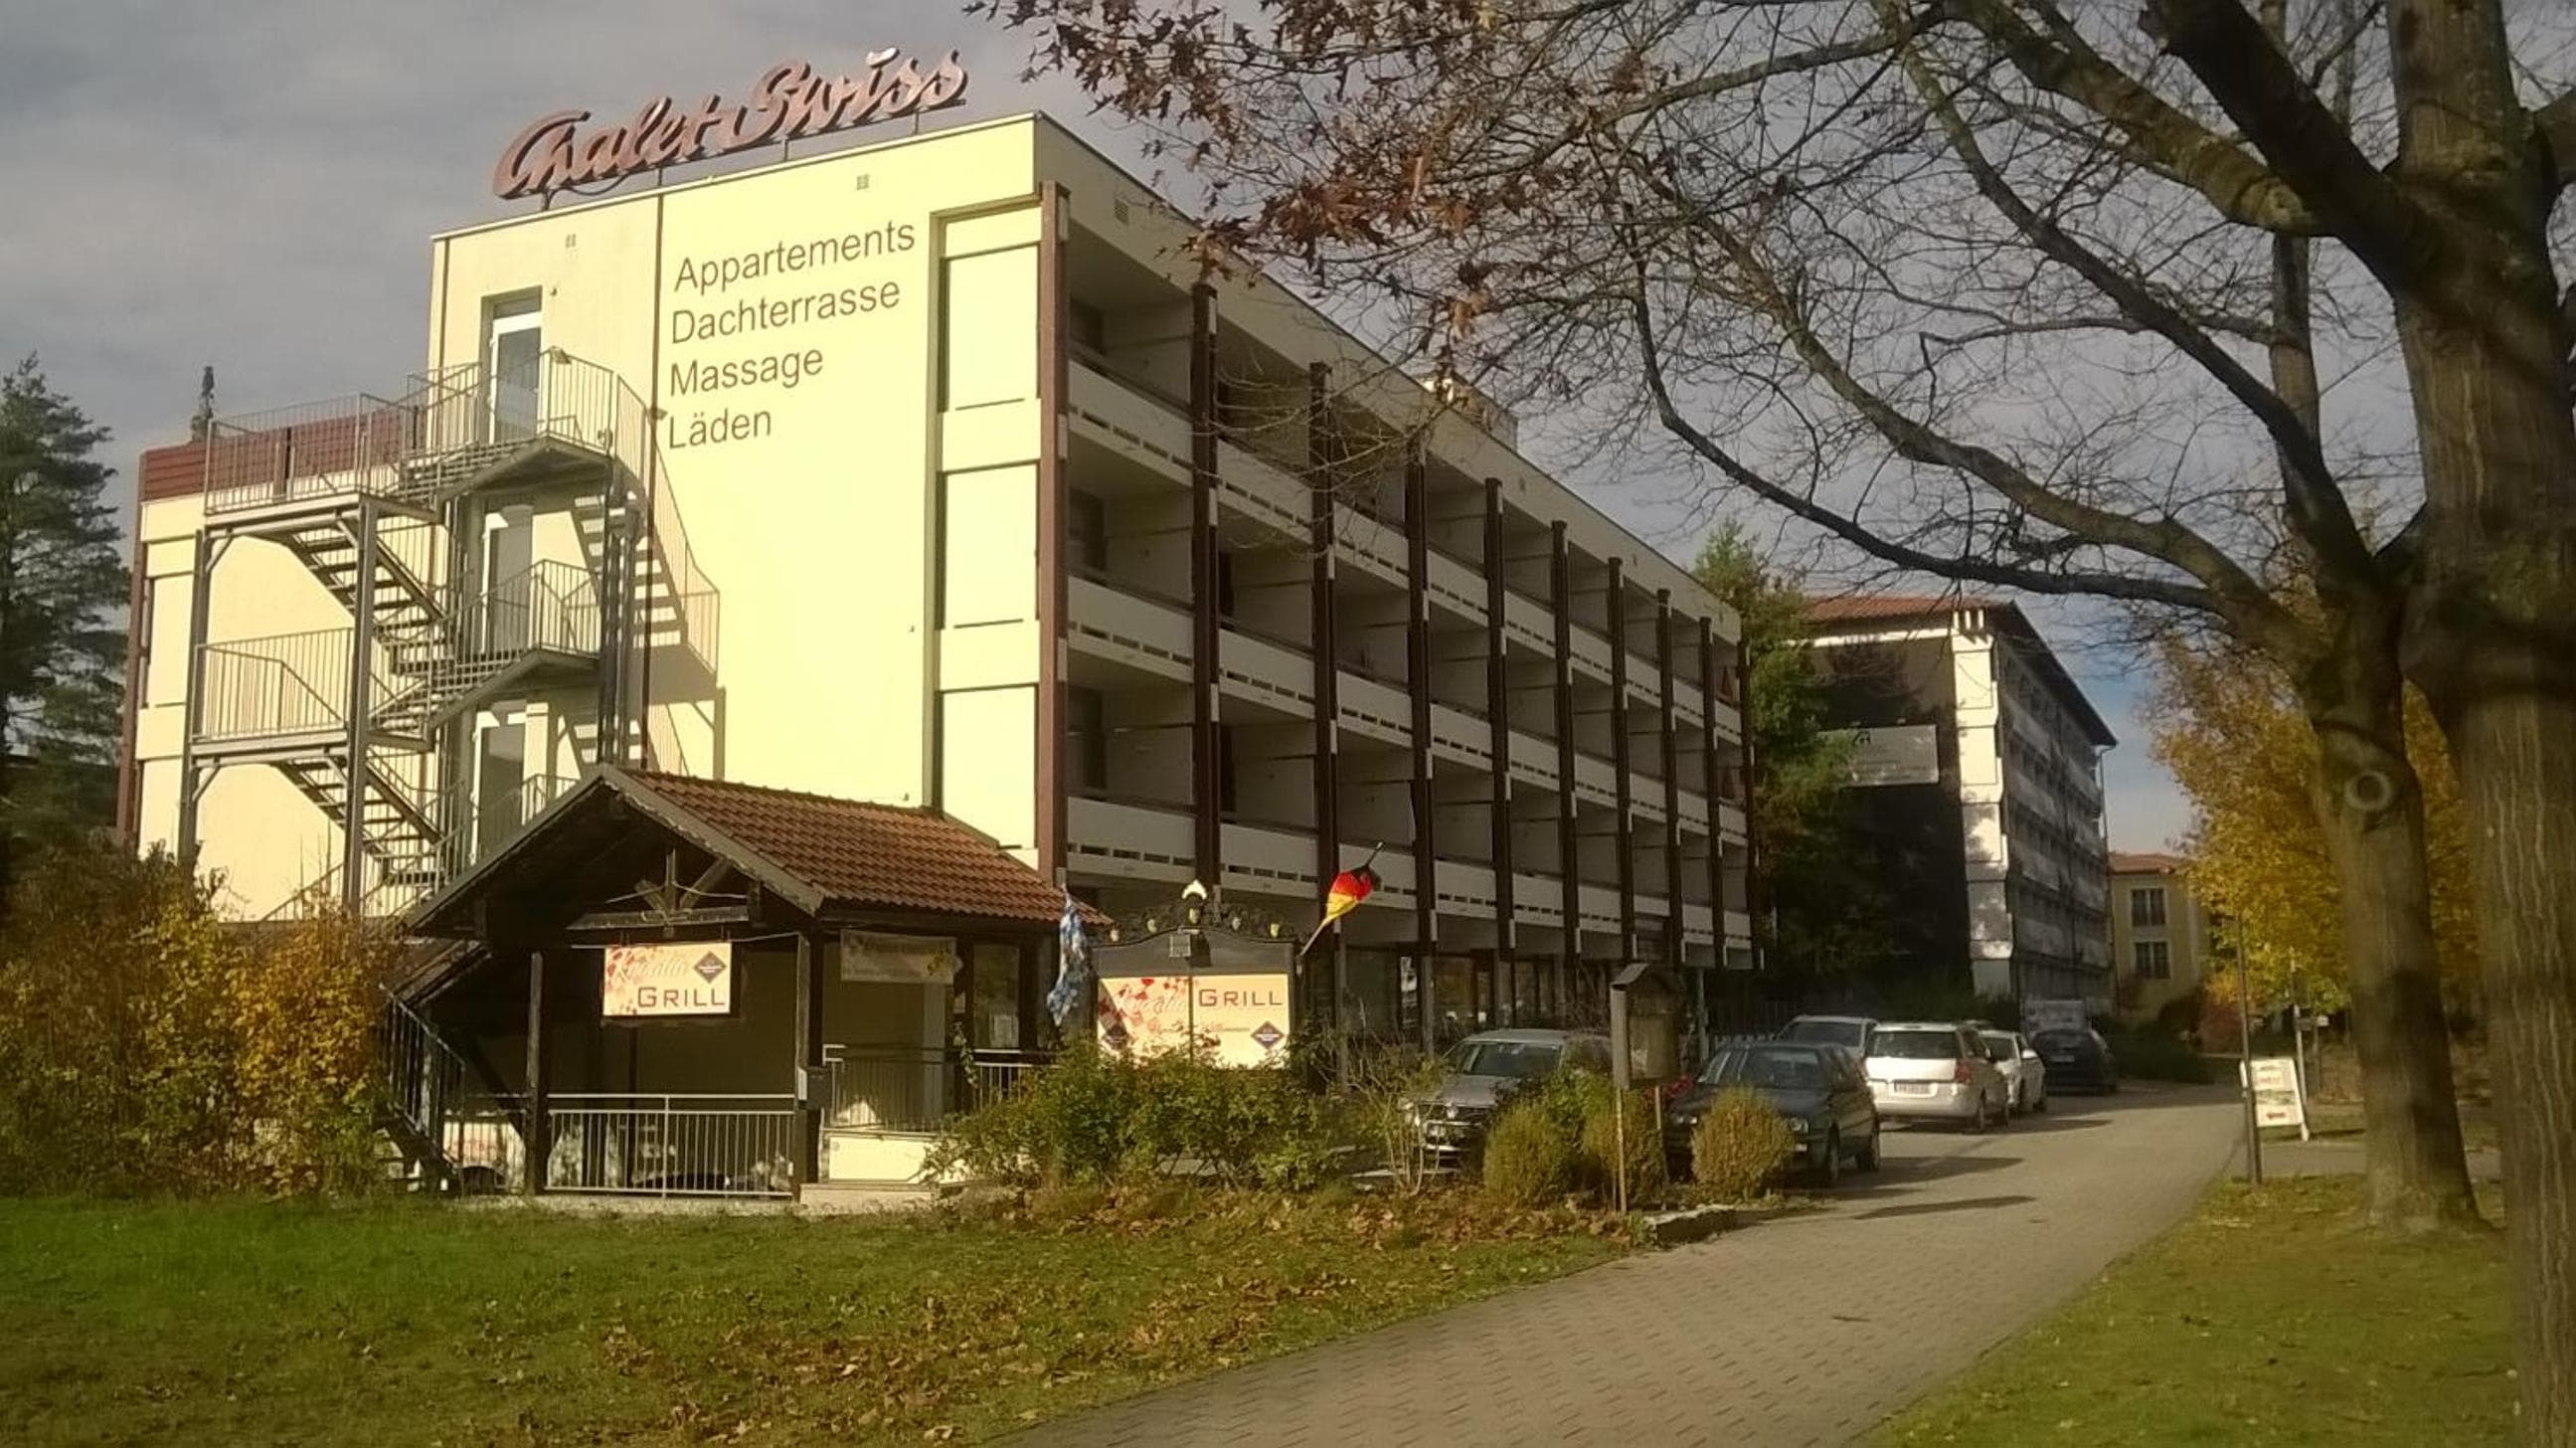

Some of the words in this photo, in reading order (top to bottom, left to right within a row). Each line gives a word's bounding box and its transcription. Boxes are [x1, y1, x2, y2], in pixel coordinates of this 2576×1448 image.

[494, 94, 724, 198] Chalet
[717, 47, 968, 153] Swiss
[674, 220, 915, 296] Appartements
[672, 281, 900, 344] Dachterrasse
[670, 348, 823, 397] Massage
[669, 407, 772, 450] Läden
